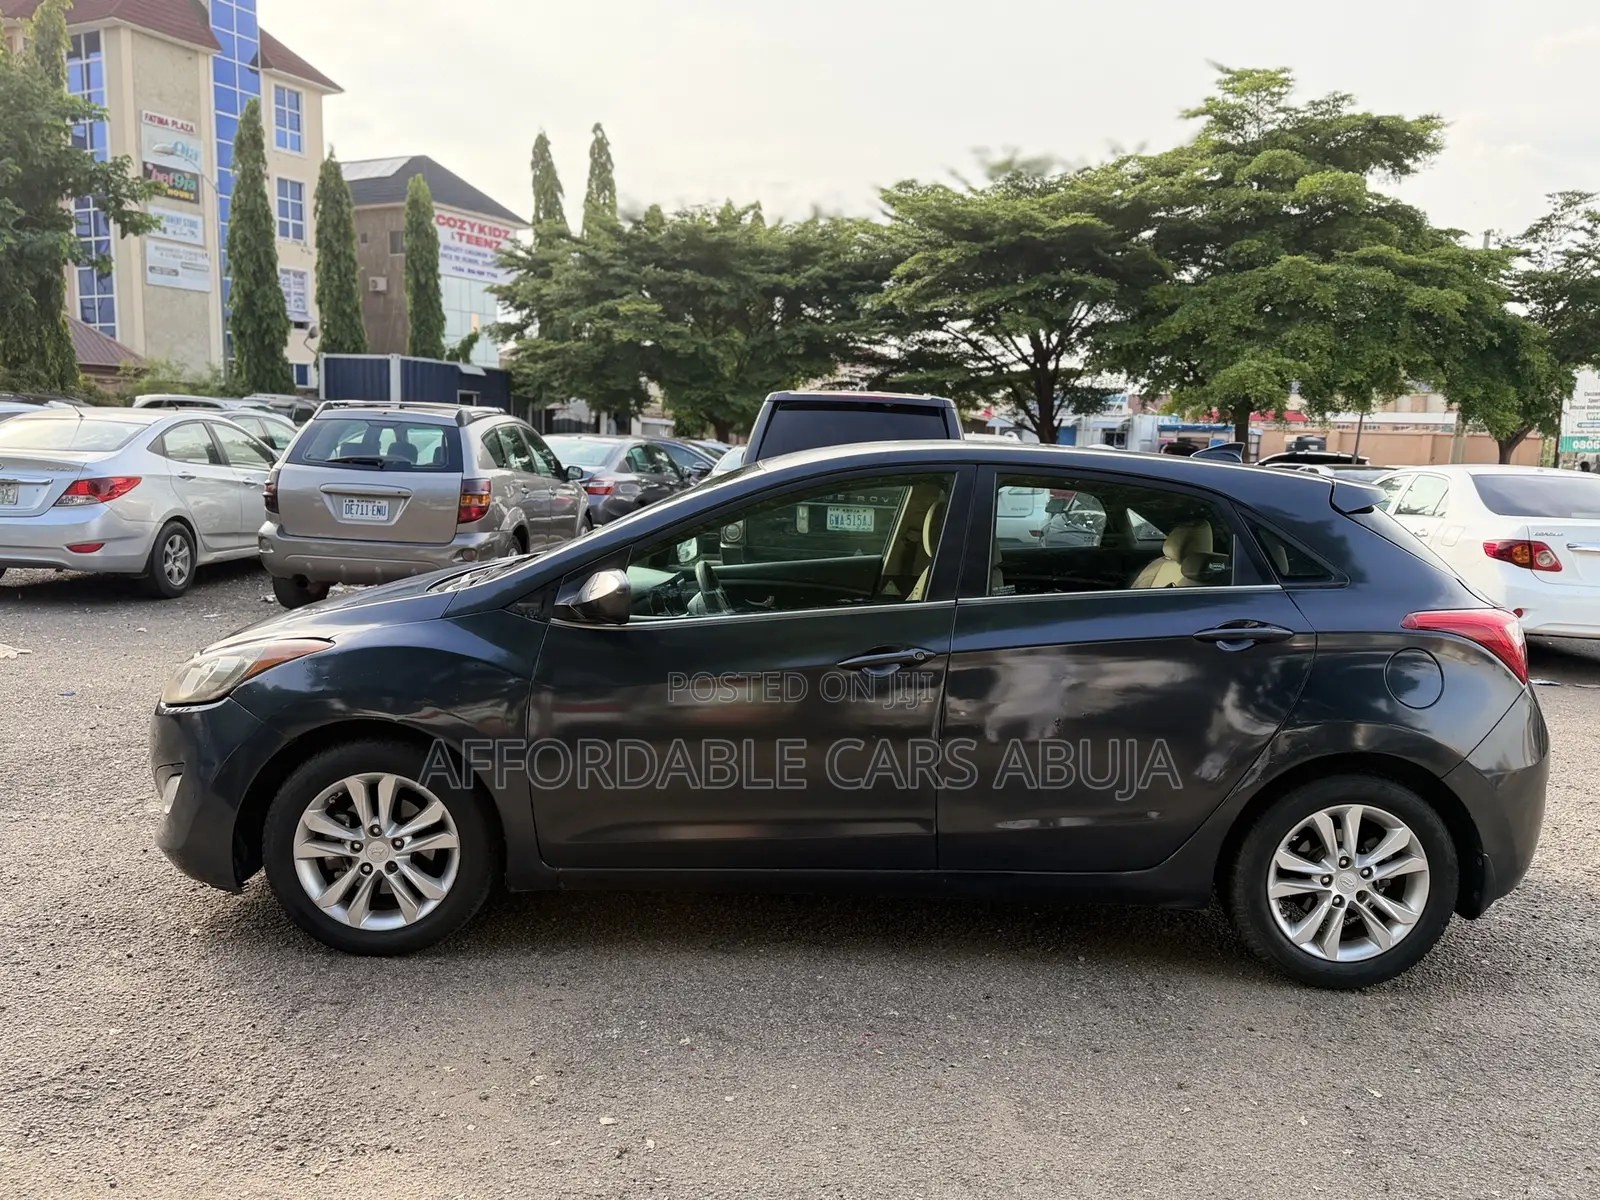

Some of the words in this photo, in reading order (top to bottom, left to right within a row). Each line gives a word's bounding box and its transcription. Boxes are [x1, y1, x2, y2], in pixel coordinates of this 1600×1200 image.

[145, 113, 169, 126] FATIMA
[171, 119, 195, 133] PLAZA
[435, 214, 511, 239] COZYKIDZ
[456, 231, 502, 249] TEENZ
